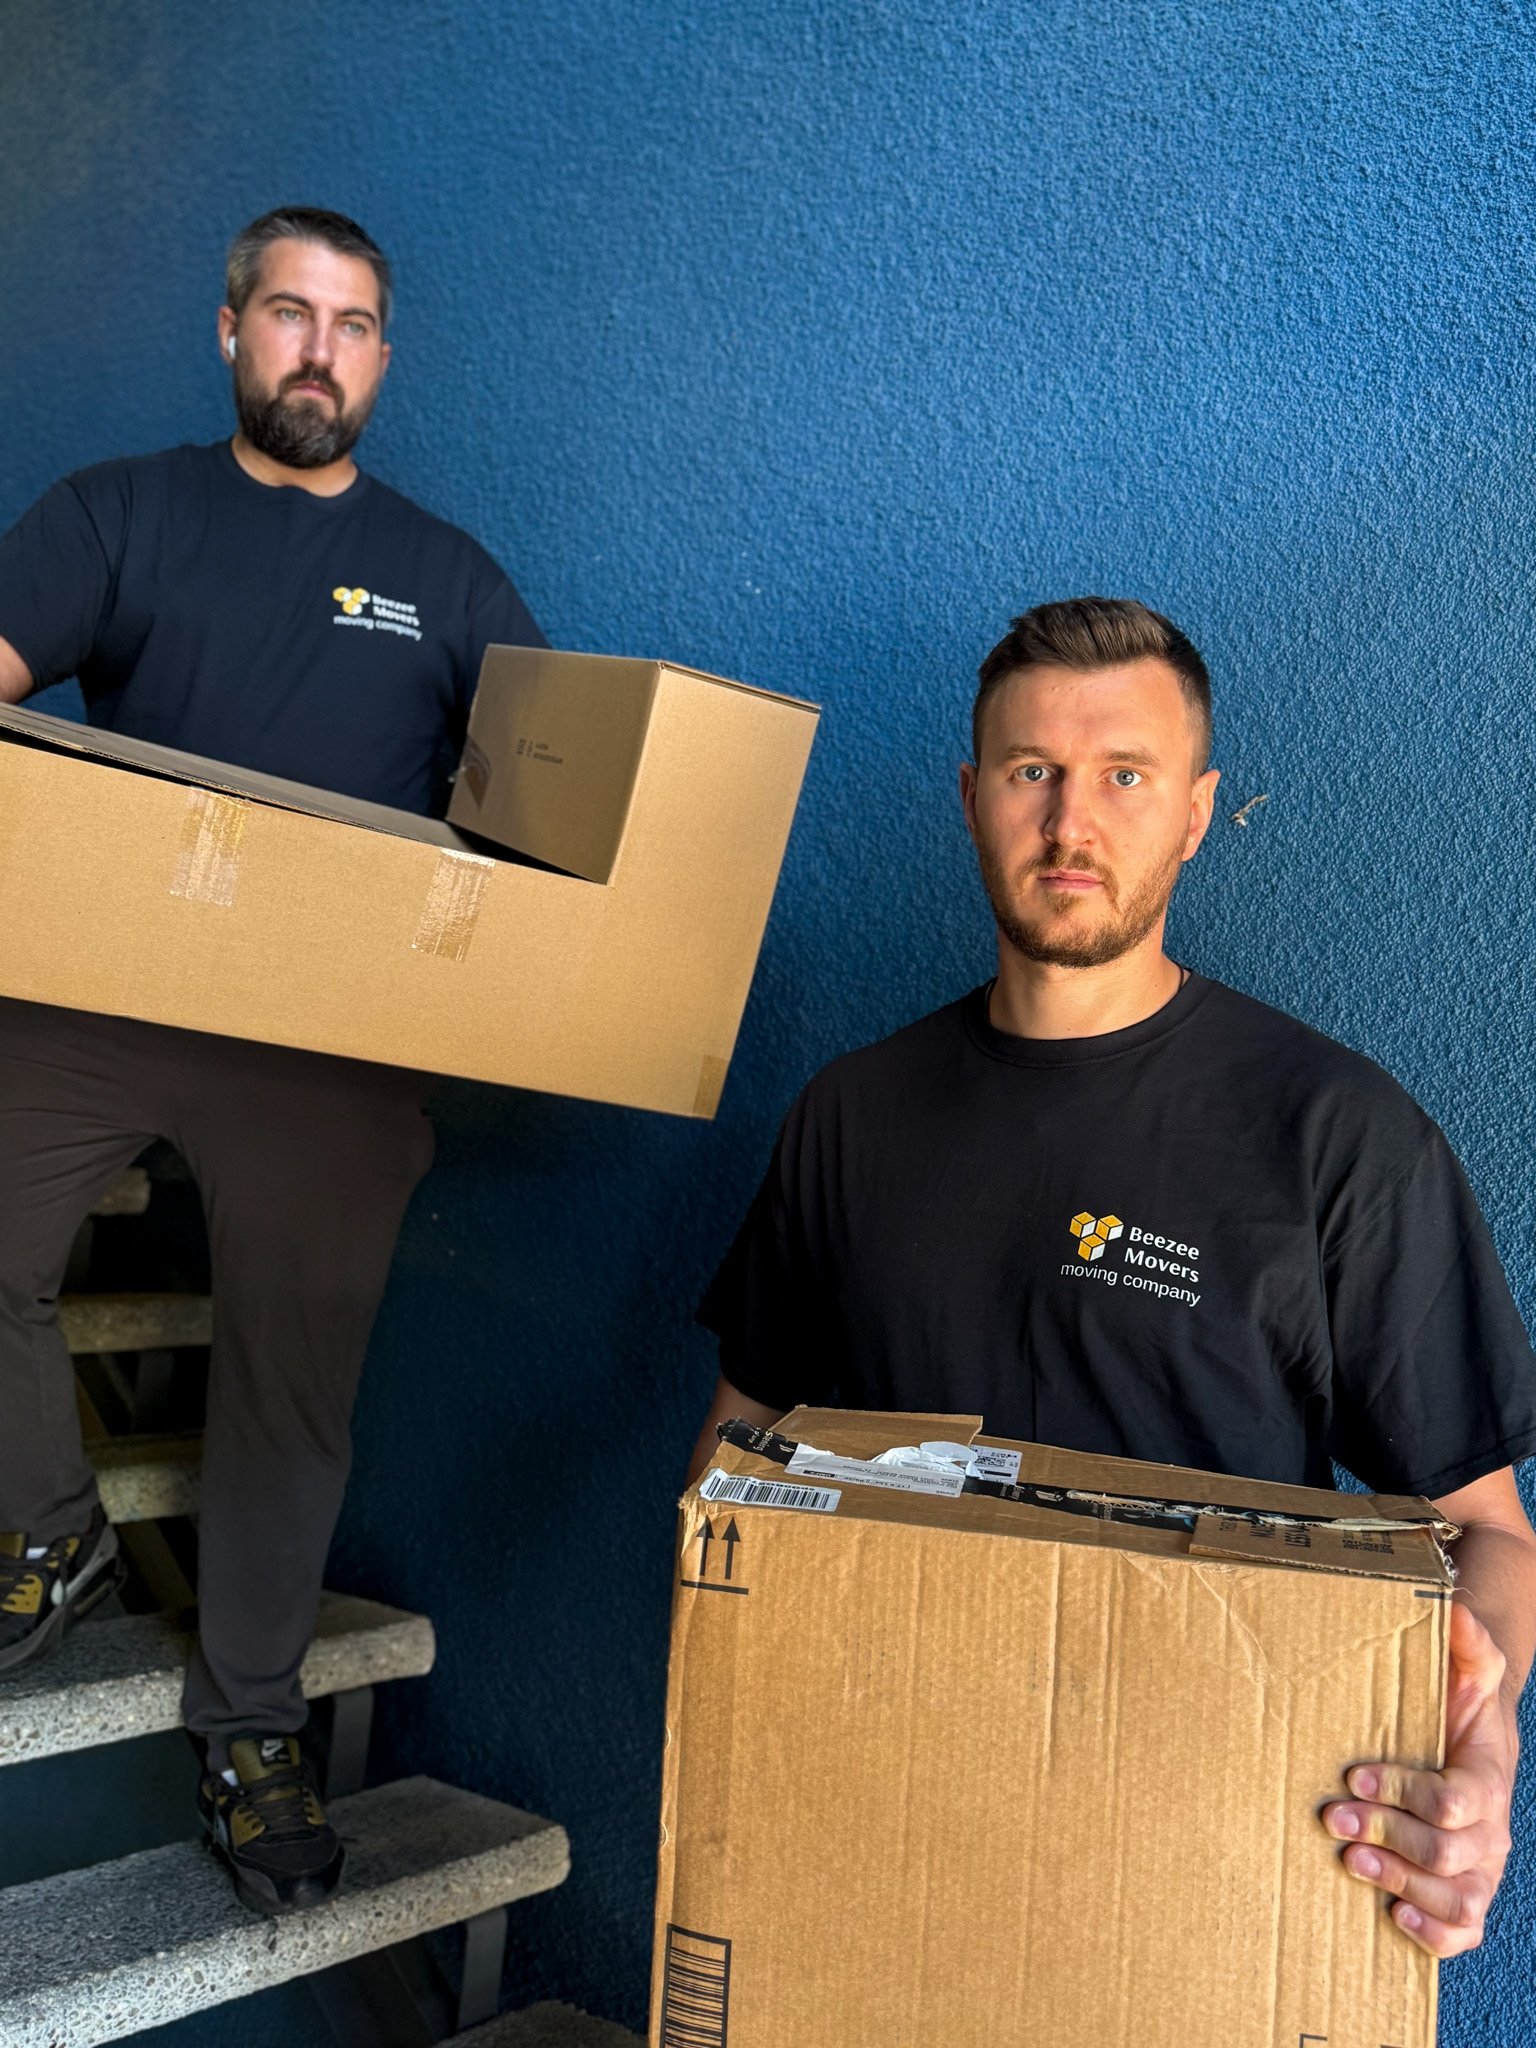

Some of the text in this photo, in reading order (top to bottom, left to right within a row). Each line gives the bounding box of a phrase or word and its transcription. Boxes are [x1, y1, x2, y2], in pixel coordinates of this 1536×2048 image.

[372, 593, 416, 614] Beezee
[373, 605, 420, 627] Movers
[1129, 1226, 1200, 1260] Beezee
[1124, 1247, 1200, 1283] Movers
[1060, 1264, 1201, 1307] moving company
